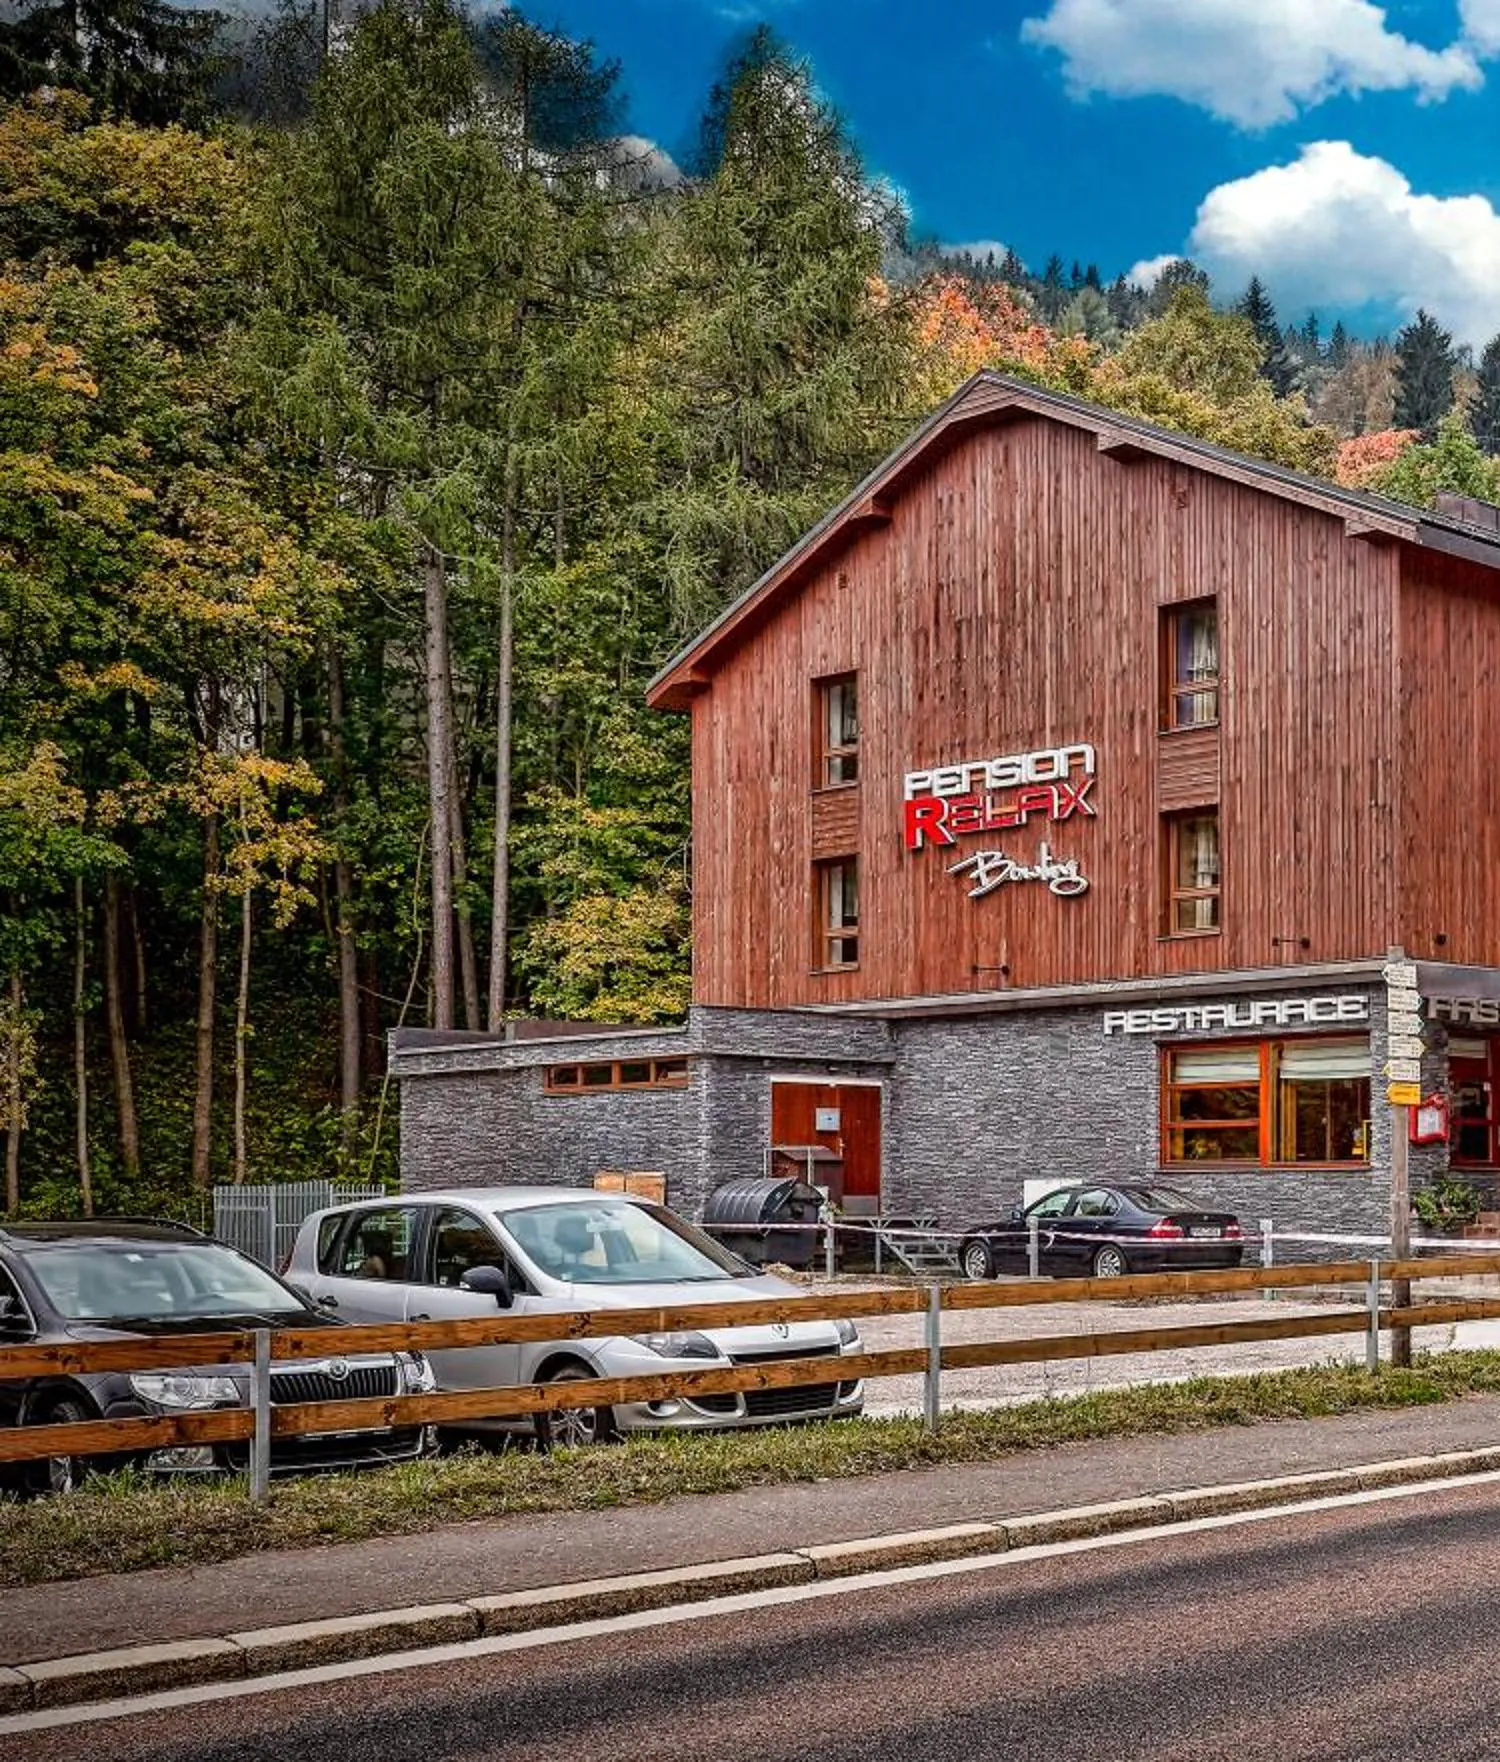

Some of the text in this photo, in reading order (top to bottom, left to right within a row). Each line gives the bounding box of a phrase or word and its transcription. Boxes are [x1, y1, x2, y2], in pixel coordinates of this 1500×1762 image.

[903, 743, 1097, 800] PENSION
[903, 779, 1098, 850] RELAX
[946, 842, 1090, 897] Bowling
[1104, 995, 1370, 1035] RESTAURACE
